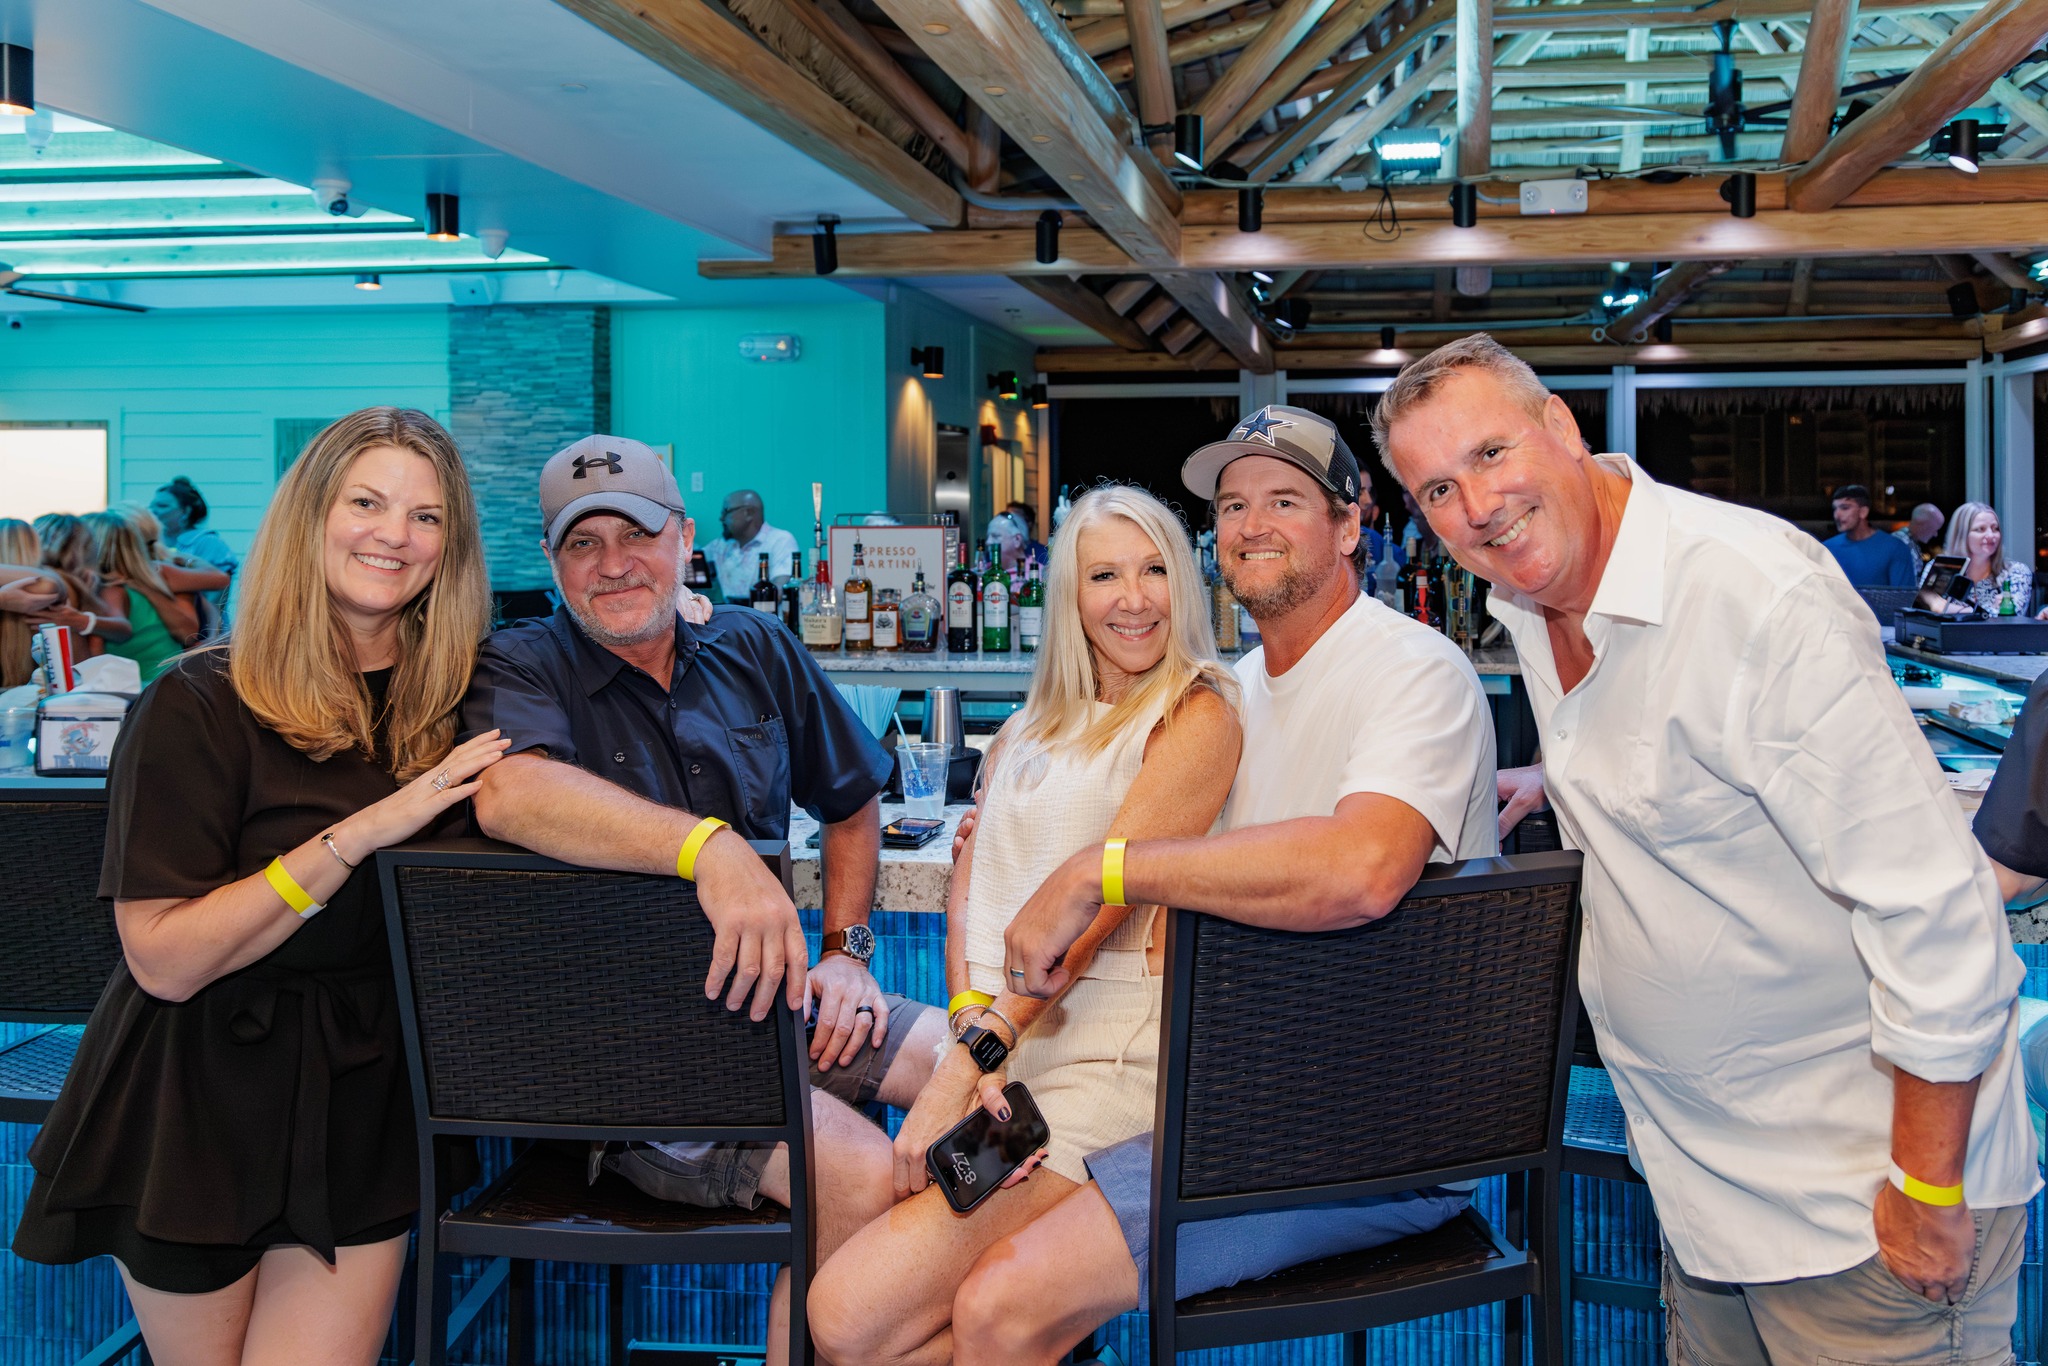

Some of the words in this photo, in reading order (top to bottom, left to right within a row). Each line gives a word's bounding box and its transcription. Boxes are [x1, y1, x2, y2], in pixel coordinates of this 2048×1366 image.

[862, 546, 916, 556] SPRESSO
[867, 559, 916, 569] ARTINI
[951, 1152, 977, 1185] 8:27
